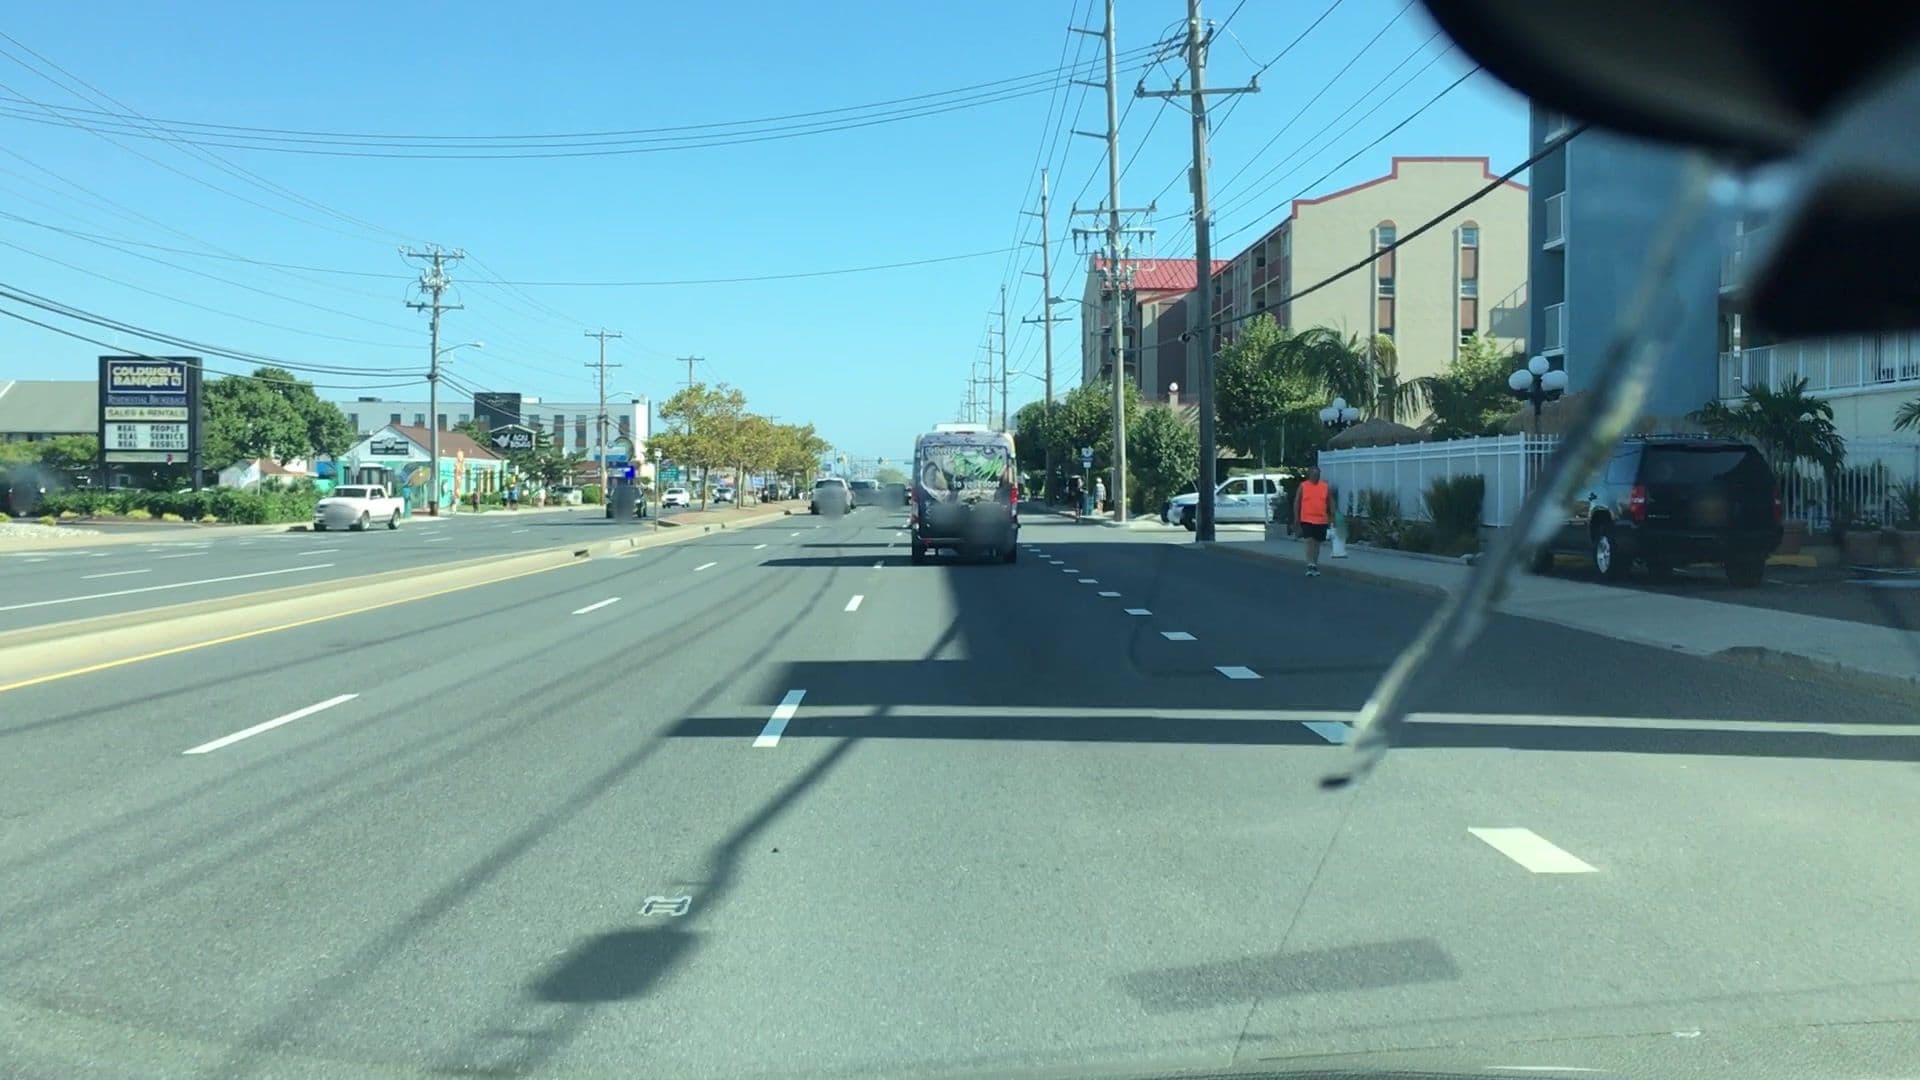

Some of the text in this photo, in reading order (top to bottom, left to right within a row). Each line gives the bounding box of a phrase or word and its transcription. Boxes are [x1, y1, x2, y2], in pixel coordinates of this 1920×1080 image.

[112, 366, 182, 377] COLDWELL
[113, 376, 169, 386] BANKER
[107, 409, 136, 417] SALES
[147, 409, 186, 417] RENTALS
[117, 424, 137, 432] REAL
[117, 432, 137, 440] REAL
[117, 440, 137, 448] REAL
